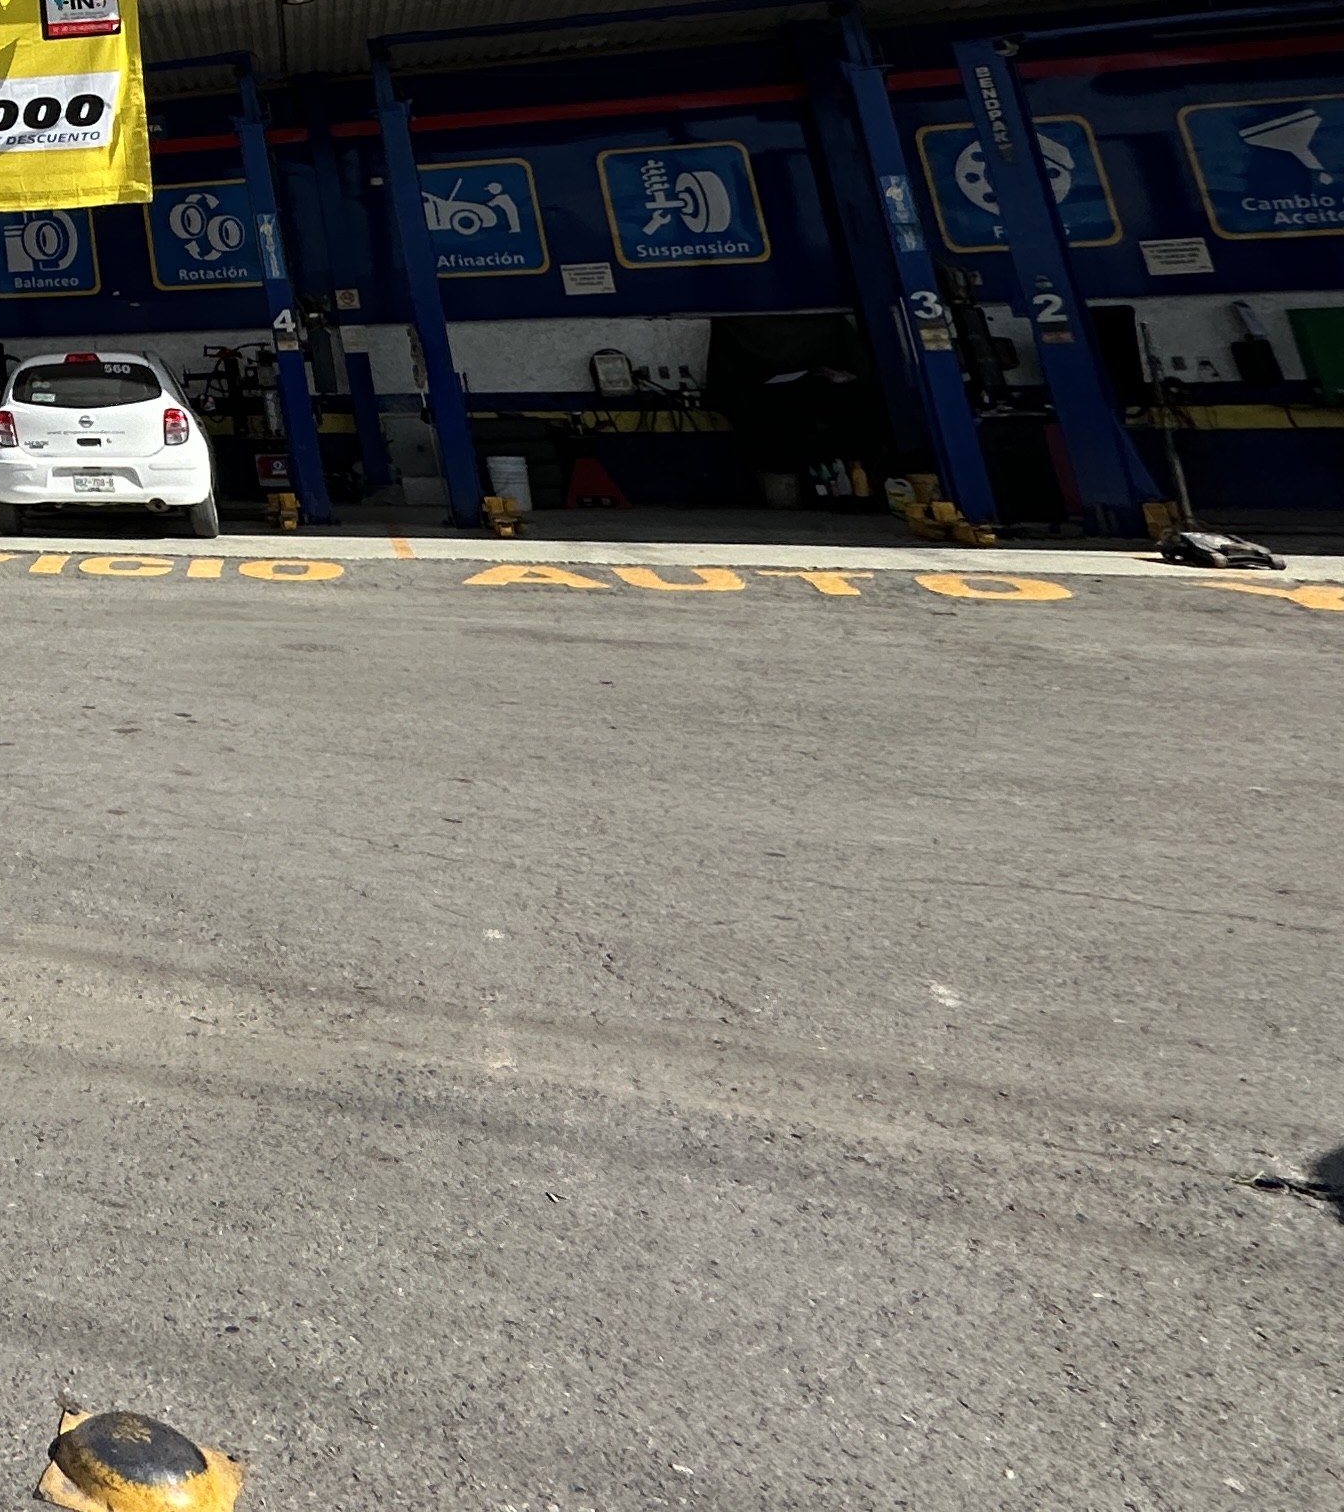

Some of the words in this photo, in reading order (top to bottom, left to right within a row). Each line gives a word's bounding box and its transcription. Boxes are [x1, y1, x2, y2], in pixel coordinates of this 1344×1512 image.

[6, 131, 102, 147] DESCUENTO
[1241, 192, 1337, 212] Cambio
[636, 237, 751, 258] Suspensión
[436, 249, 526, 269] Afinación
[14, 274, 79, 288] Balanceo
[178, 263, 248, 280] Rotación
[910, 291, 944, 319] 3
[1033, 293, 1069, 323] 2
[273, 308, 296, 333] 4
[463, 563, 1074, 601] AUTO
